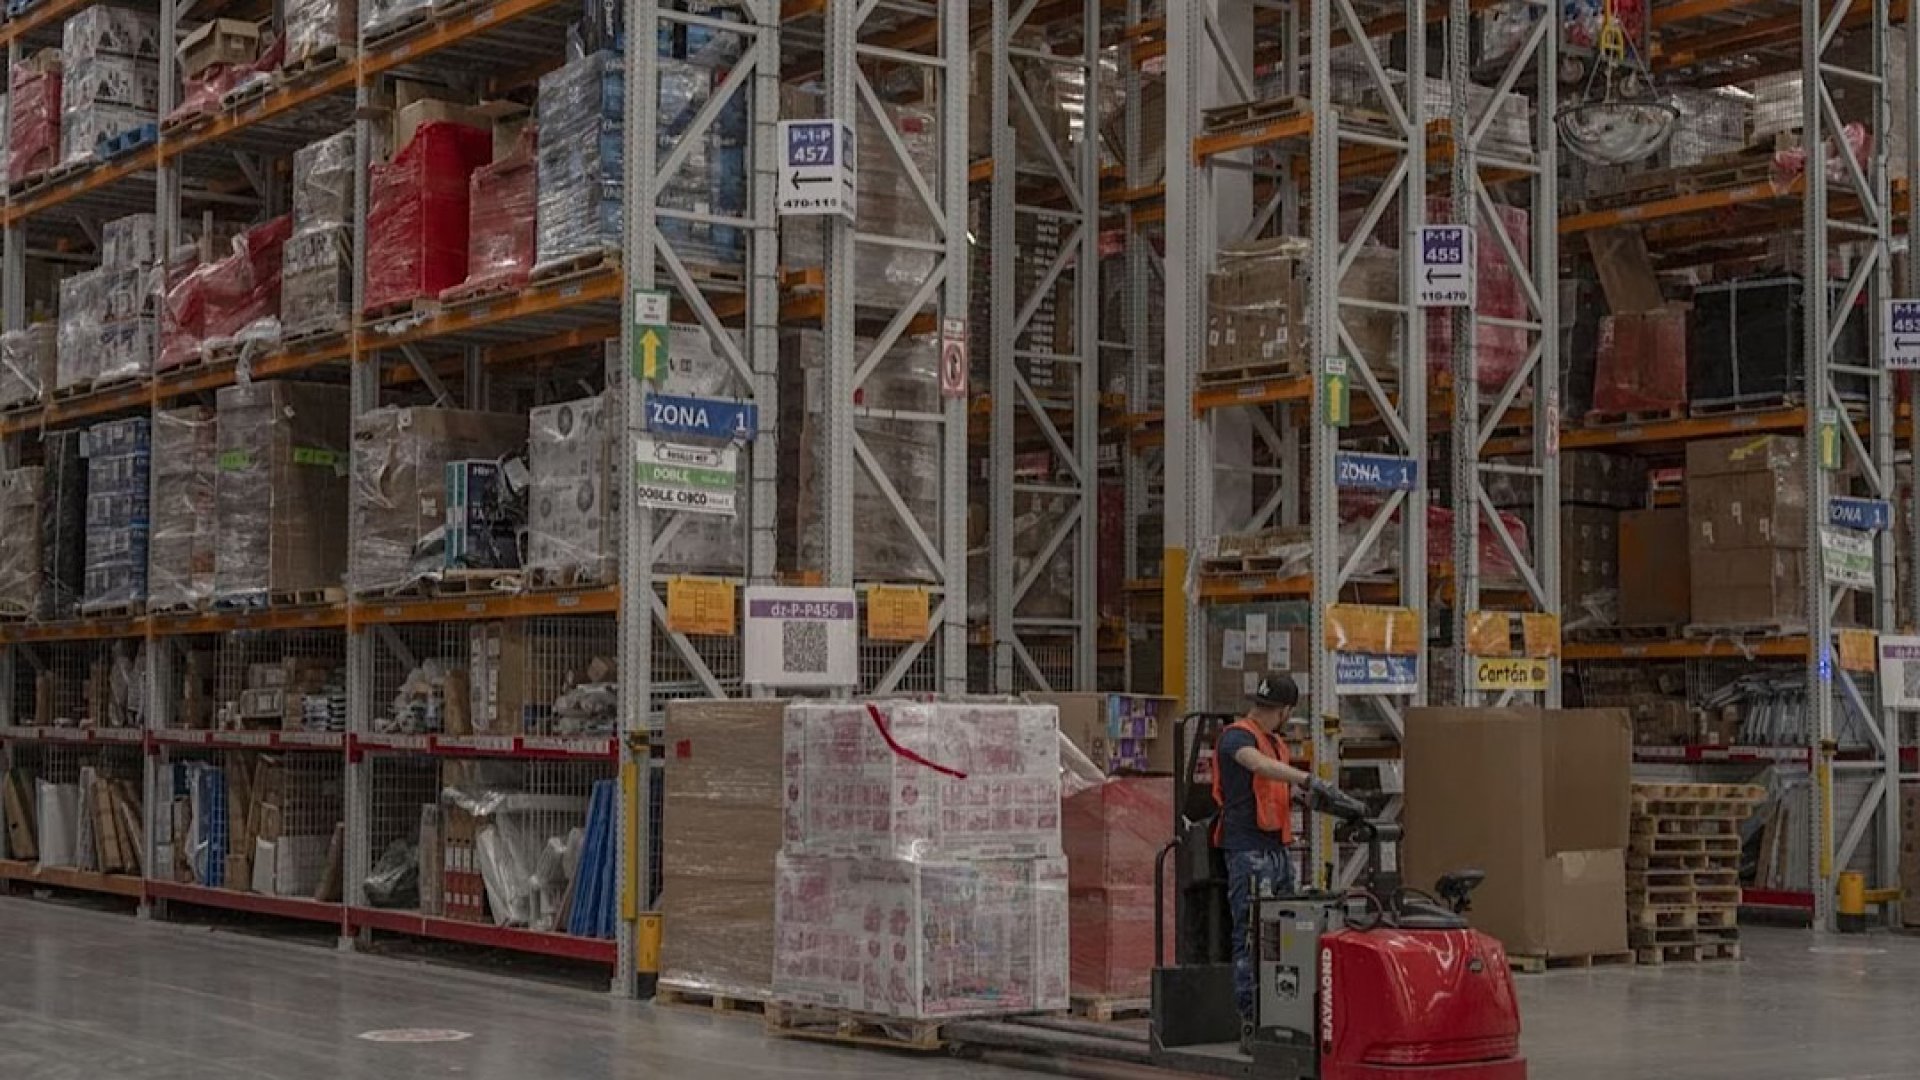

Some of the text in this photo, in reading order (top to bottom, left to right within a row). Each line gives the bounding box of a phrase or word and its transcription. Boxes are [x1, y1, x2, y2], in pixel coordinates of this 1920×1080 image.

[792, 128, 832, 143] P-1-P
[794, 146, 828, 163] 457
[1425, 230, 1461, 242] P-1-P
[1426, 247, 1460, 262] 455
[1422, 291, 1468, 301] 110-470
[653, 402, 746, 432] ZONA 1
[1341, 460, 1409, 484] ZONA 1
[639, 486, 673, 502] DOBLE
[677, 490, 708, 506] CHICO
[1874, 507, 1881, 524] 1
[770, 602, 839, 619] dz-P-P456
[1478, 662, 1529, 683] Cartón
[1321, 947, 1333, 1042] RAYMOND
